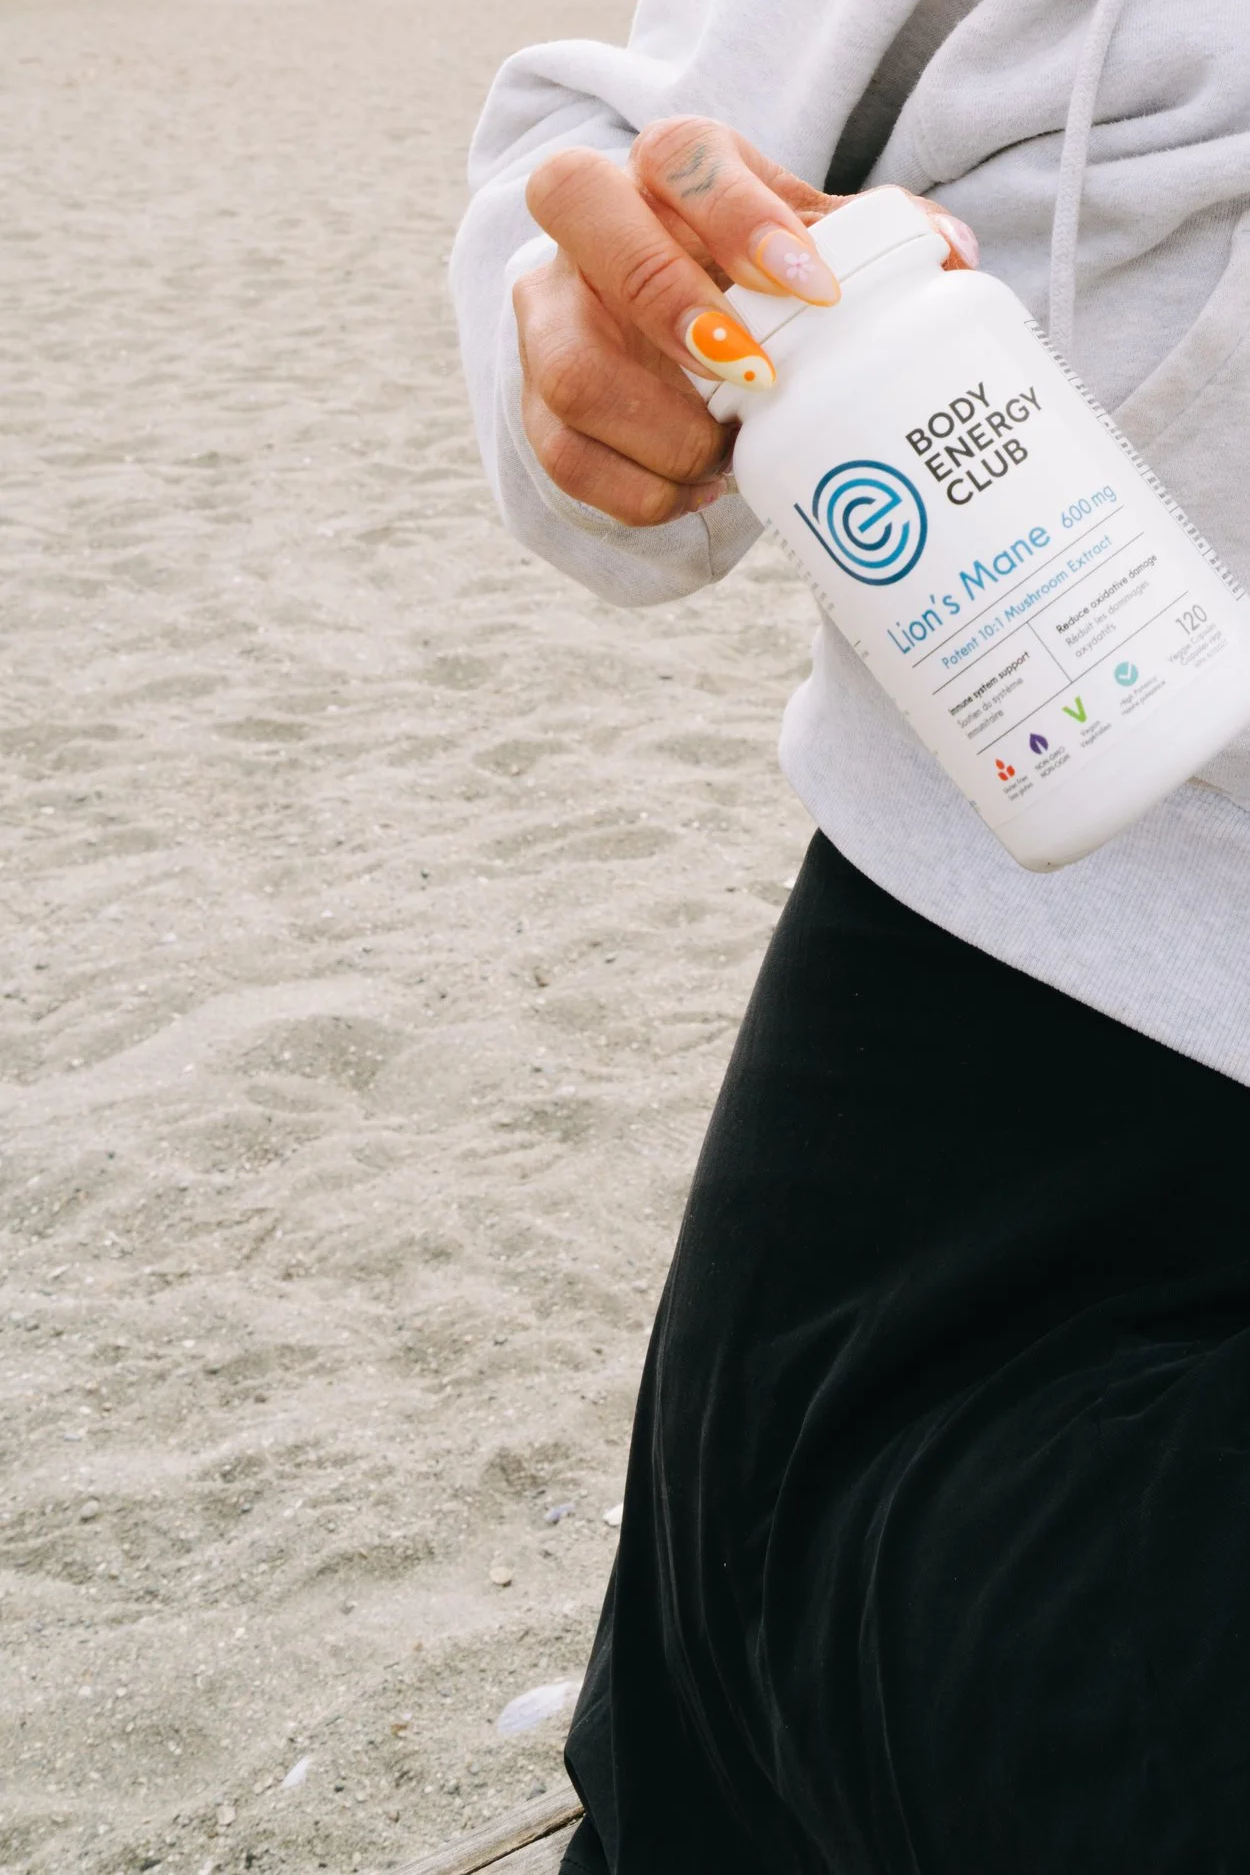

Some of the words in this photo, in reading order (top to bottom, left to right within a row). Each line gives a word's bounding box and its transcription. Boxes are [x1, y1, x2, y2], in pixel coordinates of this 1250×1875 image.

[905, 382, 990, 457] BODY
[924, 387, 1041, 483] ENERGY
[946, 438, 1028, 506] CLUB
[887, 594, 961, 654] Lion's
[959, 527, 1050, 601] Mane
[1060, 498, 1093, 529] 600
[1090, 485, 1118, 507] mg
[941, 637, 979, 670] Potent
[977, 616, 1005, 641] 10:1
[1003, 571, 1068, 622] Mushroom
[1066, 534, 1112, 574] Extract
[1055, 607, 1090, 634] Reduce
[1089, 576, 1129, 609] oxidative
[1128, 554, 1158, 579] damage
[1064, 622, 1094, 647] Réduit
[1092, 613, 1108, 626] les
[1107, 580, 1150, 616] dommages
[1074, 623, 1117, 658] oxydatifs
[1174, 604, 1208, 636] 120
[948, 695, 974, 716] Immune
[972, 676, 999, 699] system
[997, 651, 1030, 680] support
[981, 701, 993, 712] du
